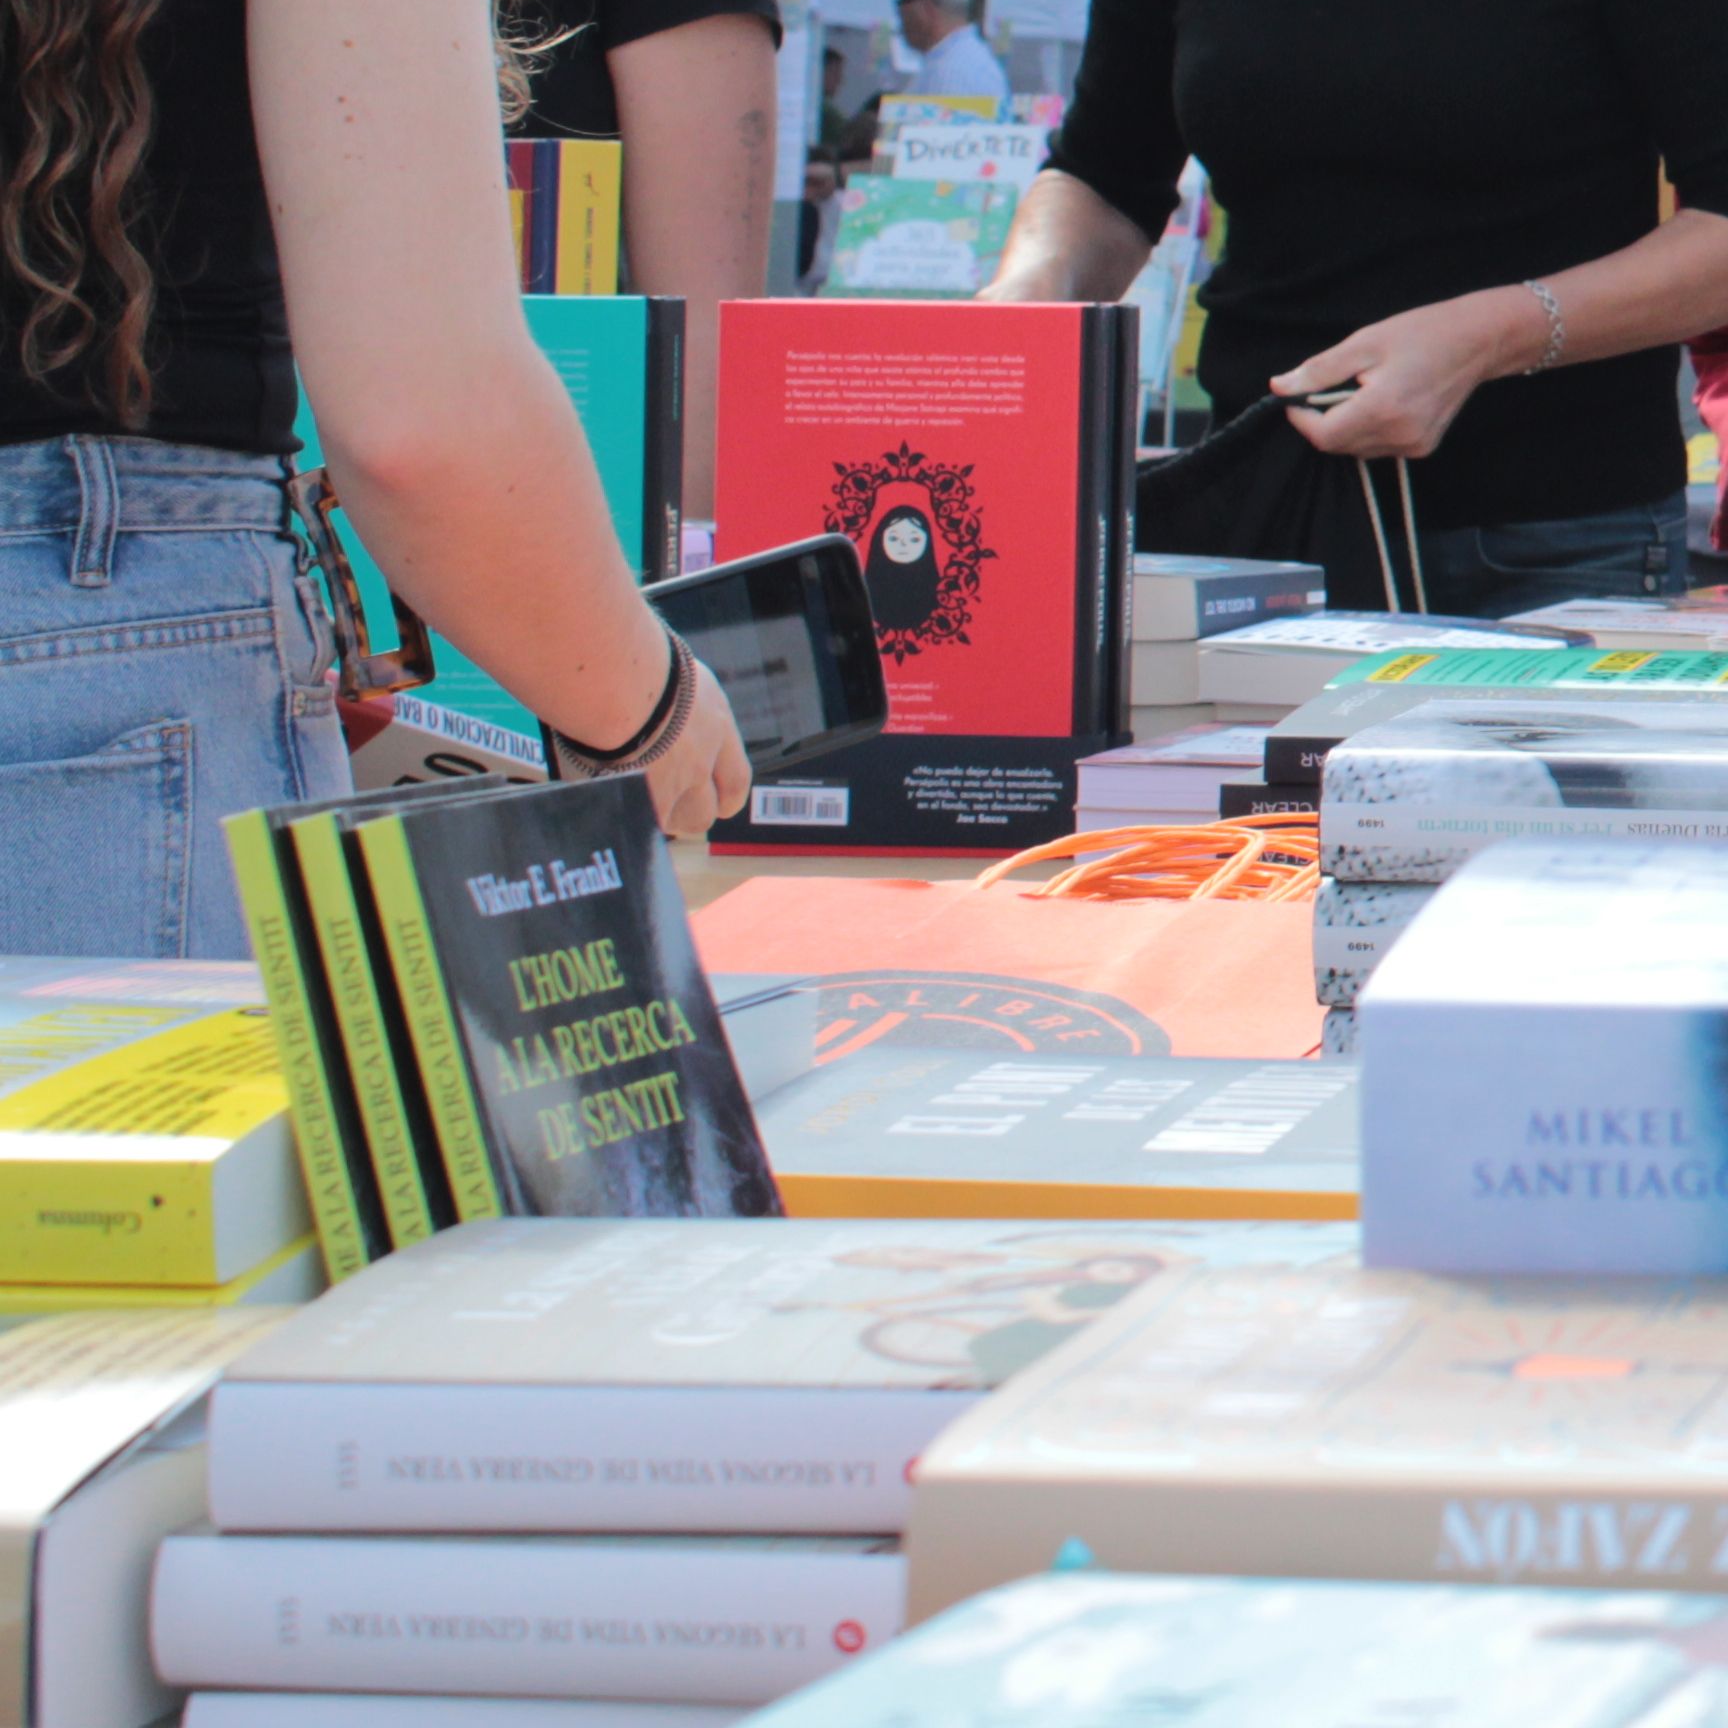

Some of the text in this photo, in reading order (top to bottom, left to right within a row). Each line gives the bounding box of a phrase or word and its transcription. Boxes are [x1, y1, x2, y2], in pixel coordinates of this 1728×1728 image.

[1356, 818, 1386, 829] 1499
[466, 846, 625, 918] Viktor E. Frankl
[1346, 941, 1375, 952] 1499
[557, 996, 697, 1079] RECERCA
[537, 1071, 687, 1162] DE SENTIT
[1526, 1108, 1695, 1149] MIKEL
[384, 1455, 463, 1482] VERN
[469, 1456, 595, 1484] GINEBRA
[600, 1458, 640, 1485] DE
[646, 1459, 715, 1486] VIDA
[718, 1459, 836, 1487] SEGONA
[838, 1461, 878, 1487] LA
[773, 1624, 807, 1651] LA
